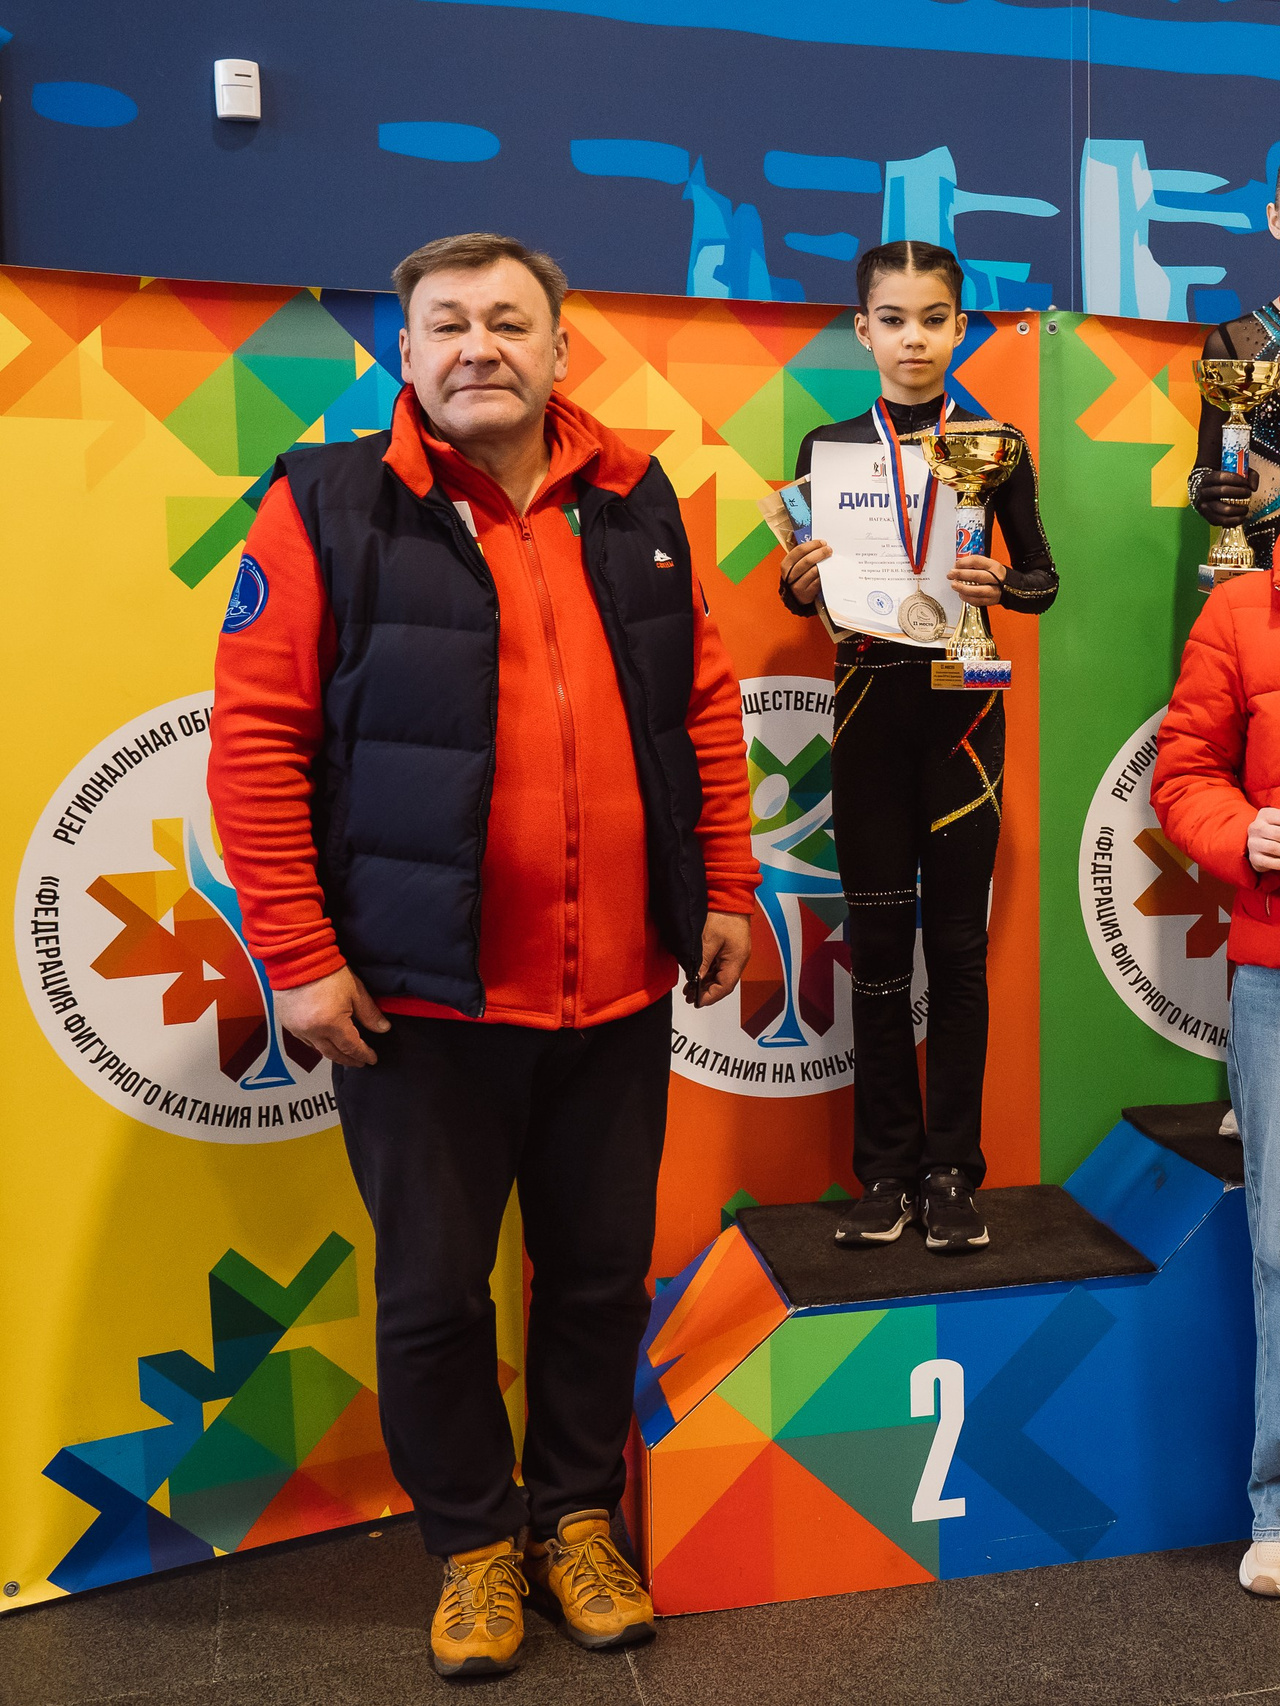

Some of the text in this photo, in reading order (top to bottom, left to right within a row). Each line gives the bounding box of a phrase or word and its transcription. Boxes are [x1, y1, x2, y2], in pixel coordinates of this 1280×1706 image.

[53, 721, 178, 846] РЕГИОНАЛЬНАЯ
[31, 876, 77, 1015] «ФЕДЕРАЦИЯ
[64, 1012, 162, 1106] ФИГУРНОГО
[158, 1090, 252, 1129] КАТАНИЯ
[257, 1104, 285, 1128] НА
[1091, 826, 1123, 943] «ФЕДЕРАЦИЯ
[1111, 942, 1182, 1025] ФИГУРНОГО
[684, 1041, 767, 1083] КАТАНИЯ
[771, 1063, 796, 1084] НА
[910, 1358, 966, 1523] 2
